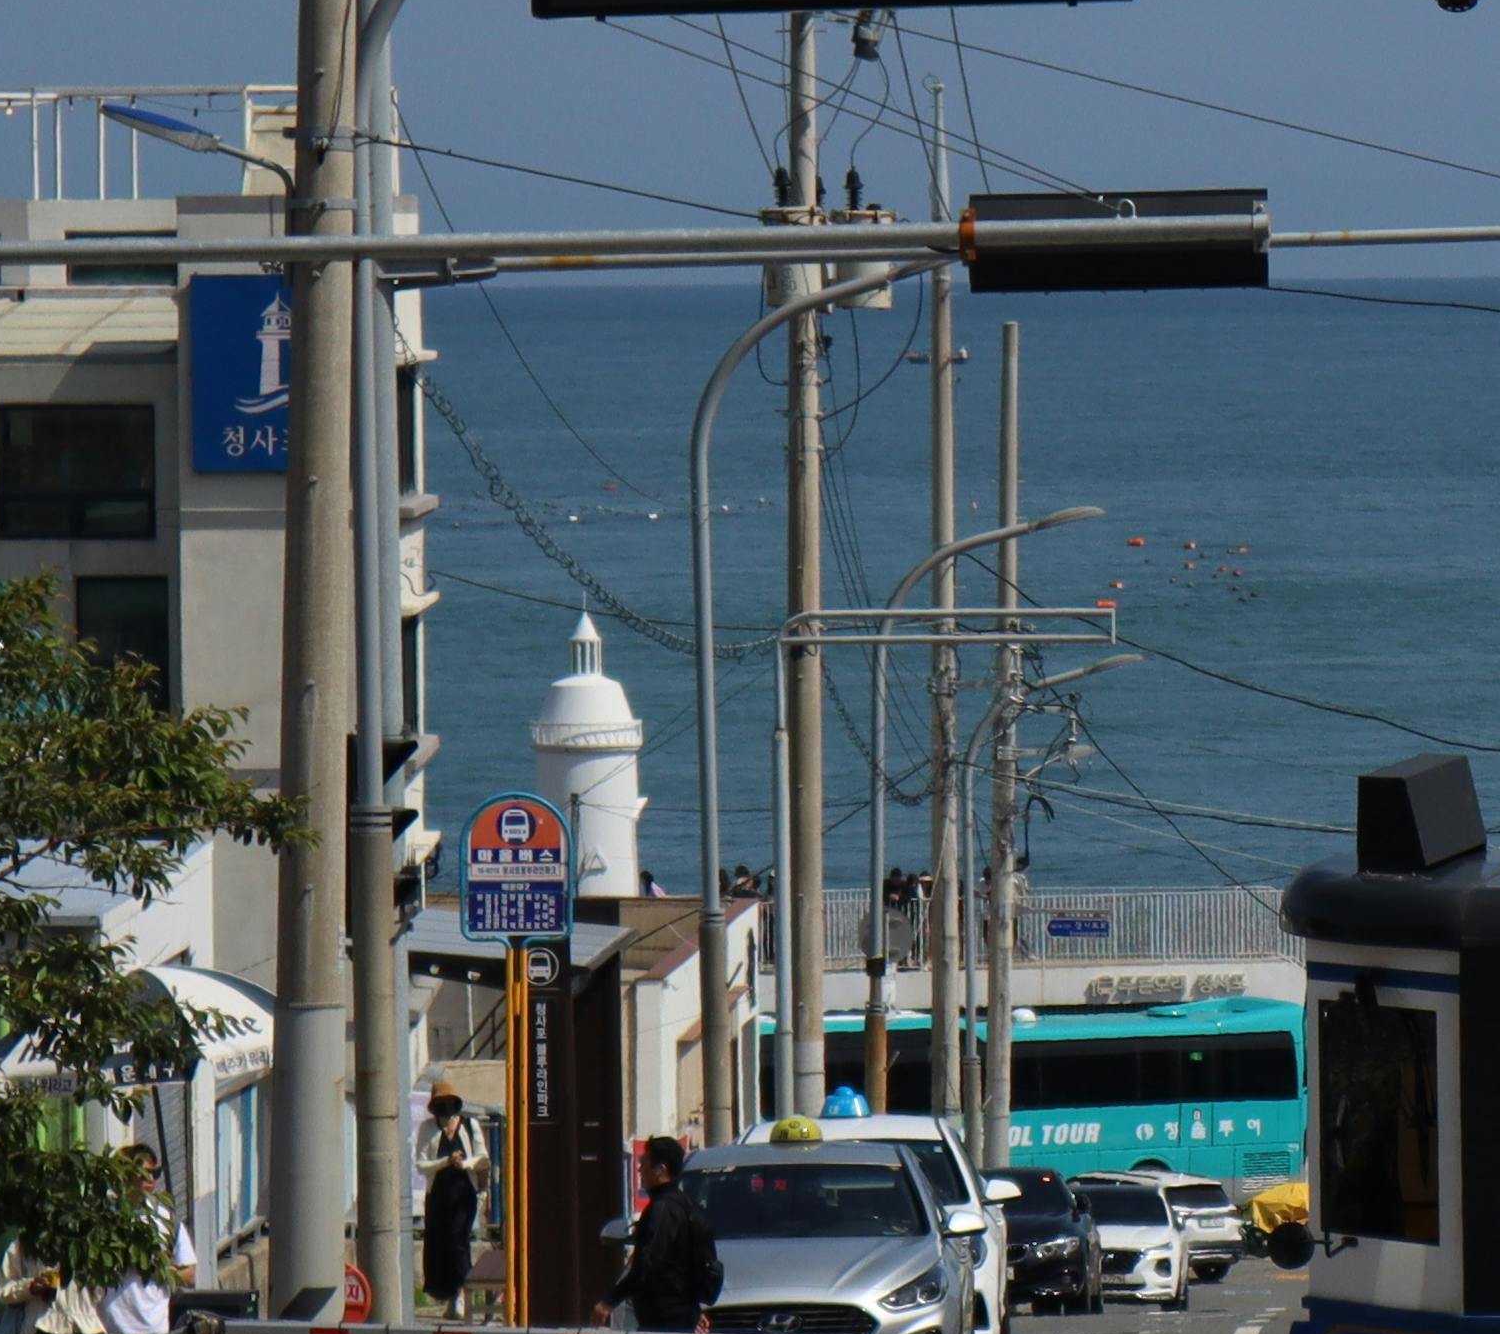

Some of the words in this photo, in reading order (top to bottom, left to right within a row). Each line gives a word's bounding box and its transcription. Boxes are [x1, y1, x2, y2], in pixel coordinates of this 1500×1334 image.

[222, 425, 289, 457] 청사
[477, 849, 554, 863] 마을버스
[1041, 1122, 1102, 1145] TOUR
